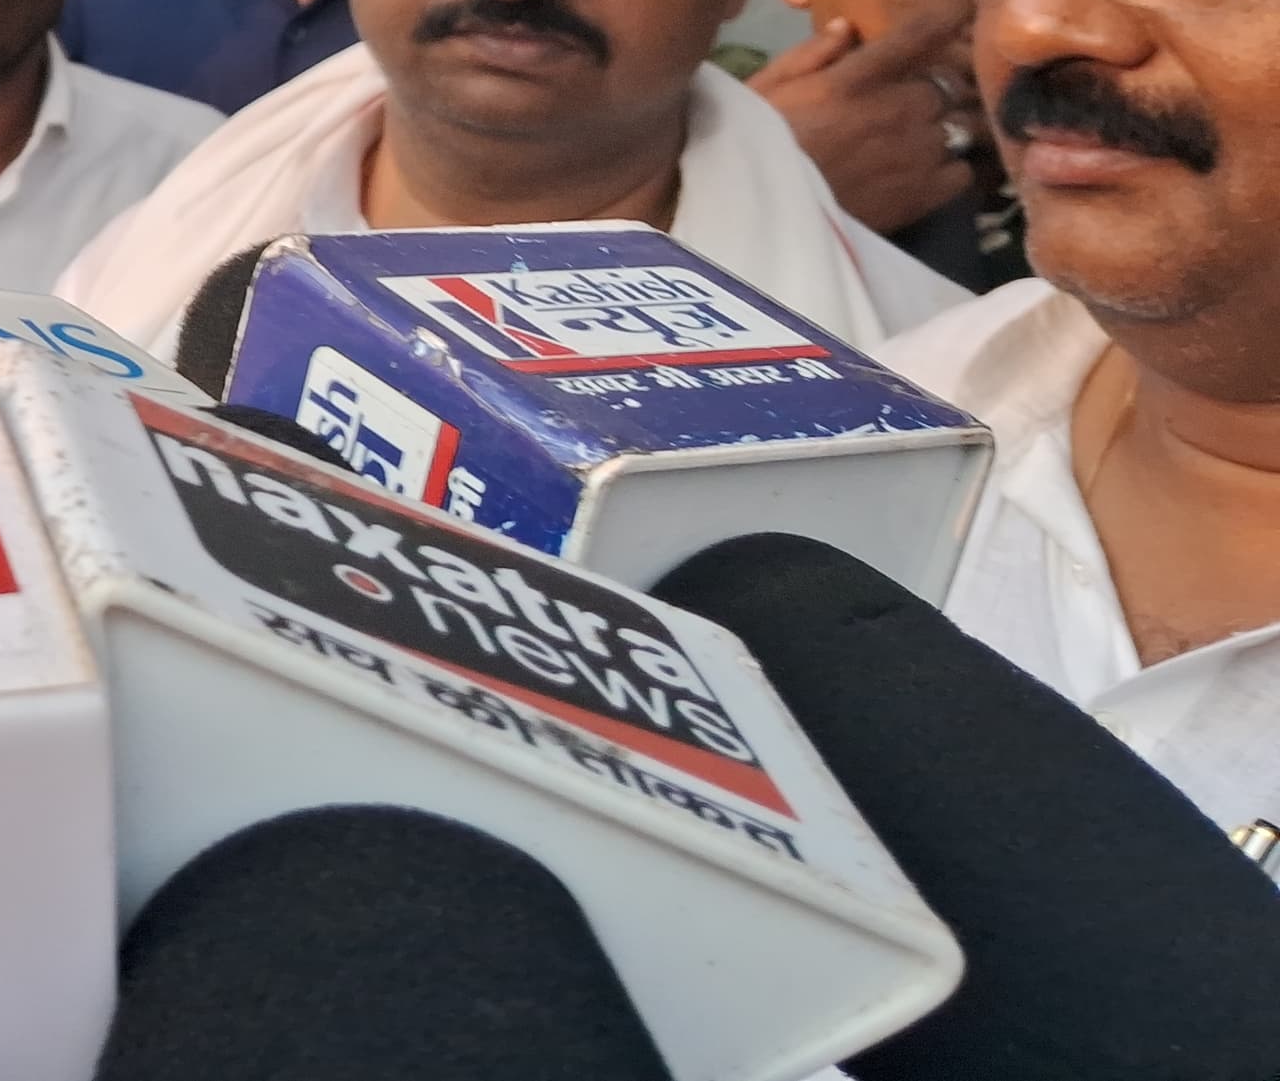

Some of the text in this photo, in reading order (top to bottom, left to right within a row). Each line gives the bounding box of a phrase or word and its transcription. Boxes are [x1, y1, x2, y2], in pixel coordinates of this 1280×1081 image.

[485, 269, 715, 307] Kashish
[152, 431, 710, 698] naxatra
[246, 604, 396, 685] सच
[408, 587, 753, 762] news
